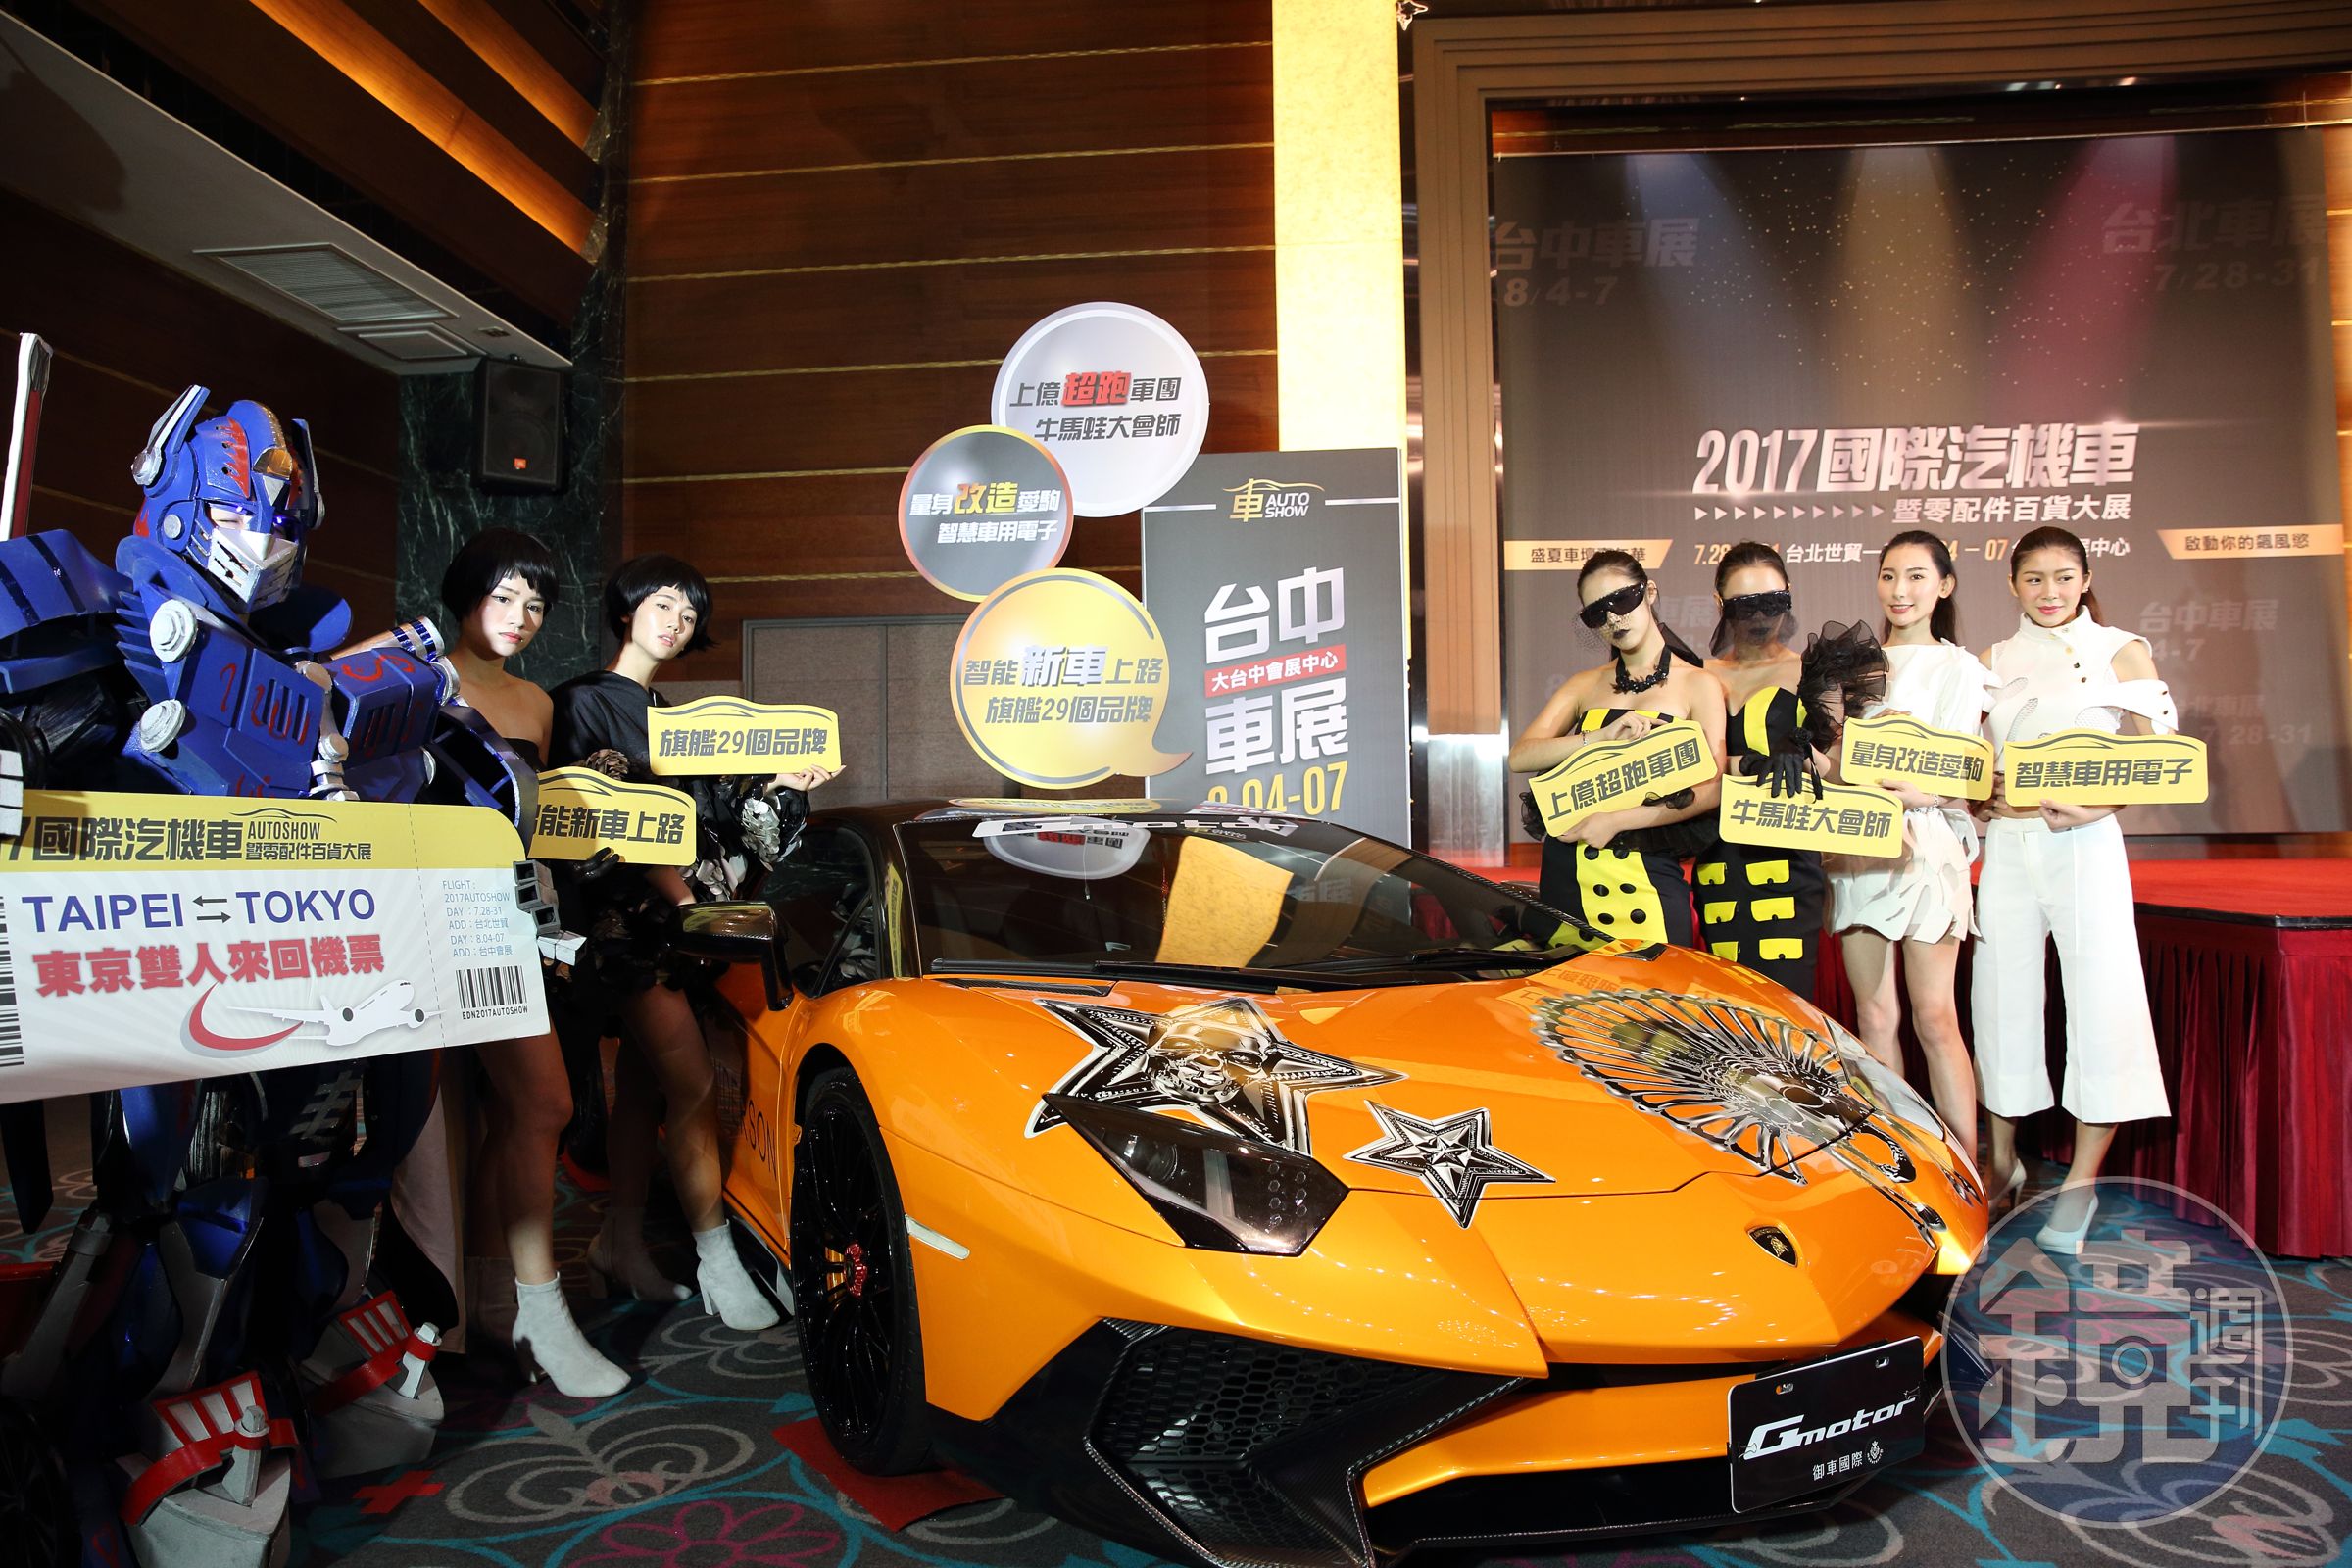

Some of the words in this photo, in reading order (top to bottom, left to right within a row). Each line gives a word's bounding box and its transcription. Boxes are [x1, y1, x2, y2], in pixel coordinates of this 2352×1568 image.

[1494, 218, 1700, 270] 台中車展
[1009, 370, 1182, 408] 上億超跑軍團
[1034, 413, 1182, 442] 牛馬蛙大會師
[1692, 422, 2139, 494] 2017國際汽機車
[909, 481, 1061, 516] 量身改造愛駒
[1264, 505, 1309, 518] SHOW
[1266, 492, 1310, 507] AUTO
[1891, 493, 2132, 525] 暨零配件百貨大展
[937, 519, 1059, 544] 智慧車用電子
[1786, 542, 1889, 564] 台北世貿一
[1204, 566, 1345, 664] 台中
[2139, 599, 2279, 634] 台中車展
[964, 645, 1164, 687] 智能新車上路
[1211, 650, 1339, 692] 大台中會展中心
[985, 695, 1154, 724] 旗艦29個品牌
[1205, 676, 1349, 776] 車展
[659, 728, 828, 758] 旗艦29個品牌
[1547, 736, 1701, 821] 上億超跑軍團
[1849, 740, 1984, 783] 量身改造愛駒
[2014, 757, 2194, 789] 智慧車用電子
[247, 820, 321, 840] AUTOSHOW
[536, 804, 686, 846] 能新車上路
[1730, 798, 1893, 840] 牛馬蛙大會師
[245, 842, 372, 861] 暨零配件百貨大展
[22, 892, 184, 932] TAIPEI
[235, 888, 375, 925] TOKYO
[445, 892, 511, 903] 2017AUTOSHOW
[32, 934, 385, 998] 東京雙人來回機票
[463, 1005, 528, 1021] EDN2017AUTOSHOW
[741, 1099, 777, 1182] SON
[1743, 1396, 1916, 1460] Gmotor
[1812, 1450, 1863, 1481] 御車國際
